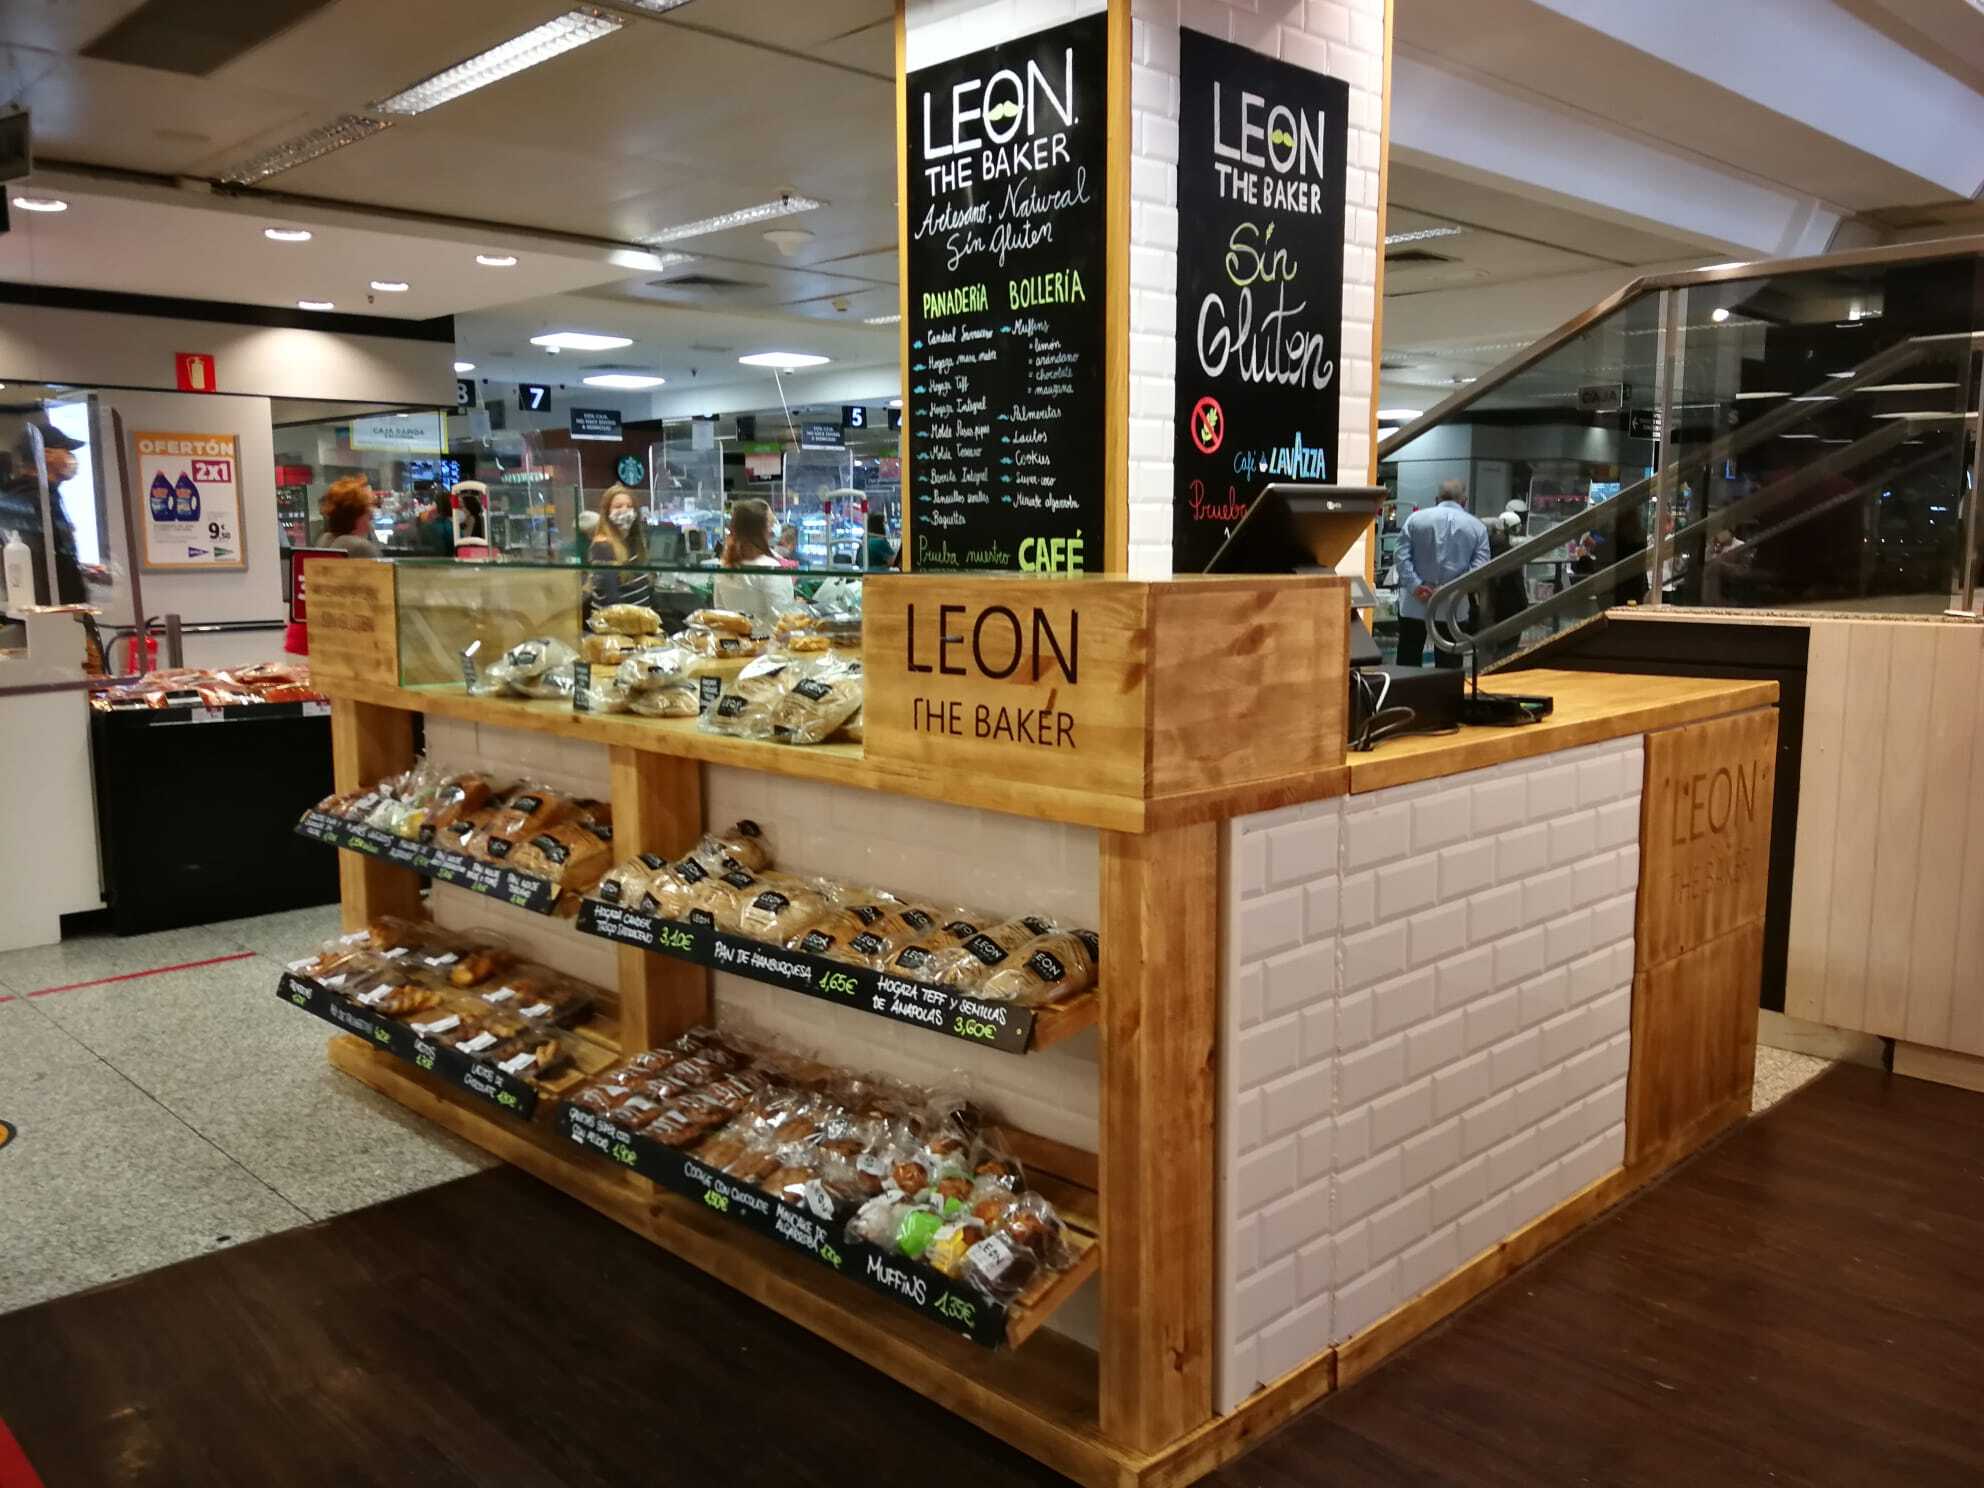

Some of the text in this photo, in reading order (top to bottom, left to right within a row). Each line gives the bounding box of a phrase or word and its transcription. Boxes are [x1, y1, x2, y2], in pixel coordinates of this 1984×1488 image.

[1213, 81, 1325, 180] LEON
[925, 132, 1070, 197] THE BAKER
[999, 166, 1090, 219] Natural
[1214, 162, 1322, 214] THE BAKER
[1009, 269, 1086, 310] BOLLERÍA
[1012, 318, 1049, 337] Muffins
[1197, 278, 1334, 390] Gluten
[529, 387, 544, 409] 7
[852, 407, 863, 427] 5
[140, 440, 234, 455] OFERTÓN
[1015, 449, 1050, 466] Cookies
[1234, 431, 1326, 481] Café LAVAZZA
[917, 529, 1083, 572] Prueba nuestro CAFÉ
[907, 603, 1078, 684] LEON
[975, 704, 1076, 748] BAKER
[1672, 760, 1757, 846] LEON
[715, 941, 734, 963] PAN
[736, 949, 751, 964] DE
[819, 970, 858, 996] 1,65€
[974, 937, 1003, 959] LEON
[1035, 952, 1061, 977] EON
[872, 995, 885, 1010] DE
[954, 1017, 997, 1040] 3,60€
[877, 975, 919, 1001] HOGAZA
[921, 988, 948, 1006] TEFF
[958, 1000, 1007, 1026] SEMILLAS
[714, 1179, 730, 1195] CON
